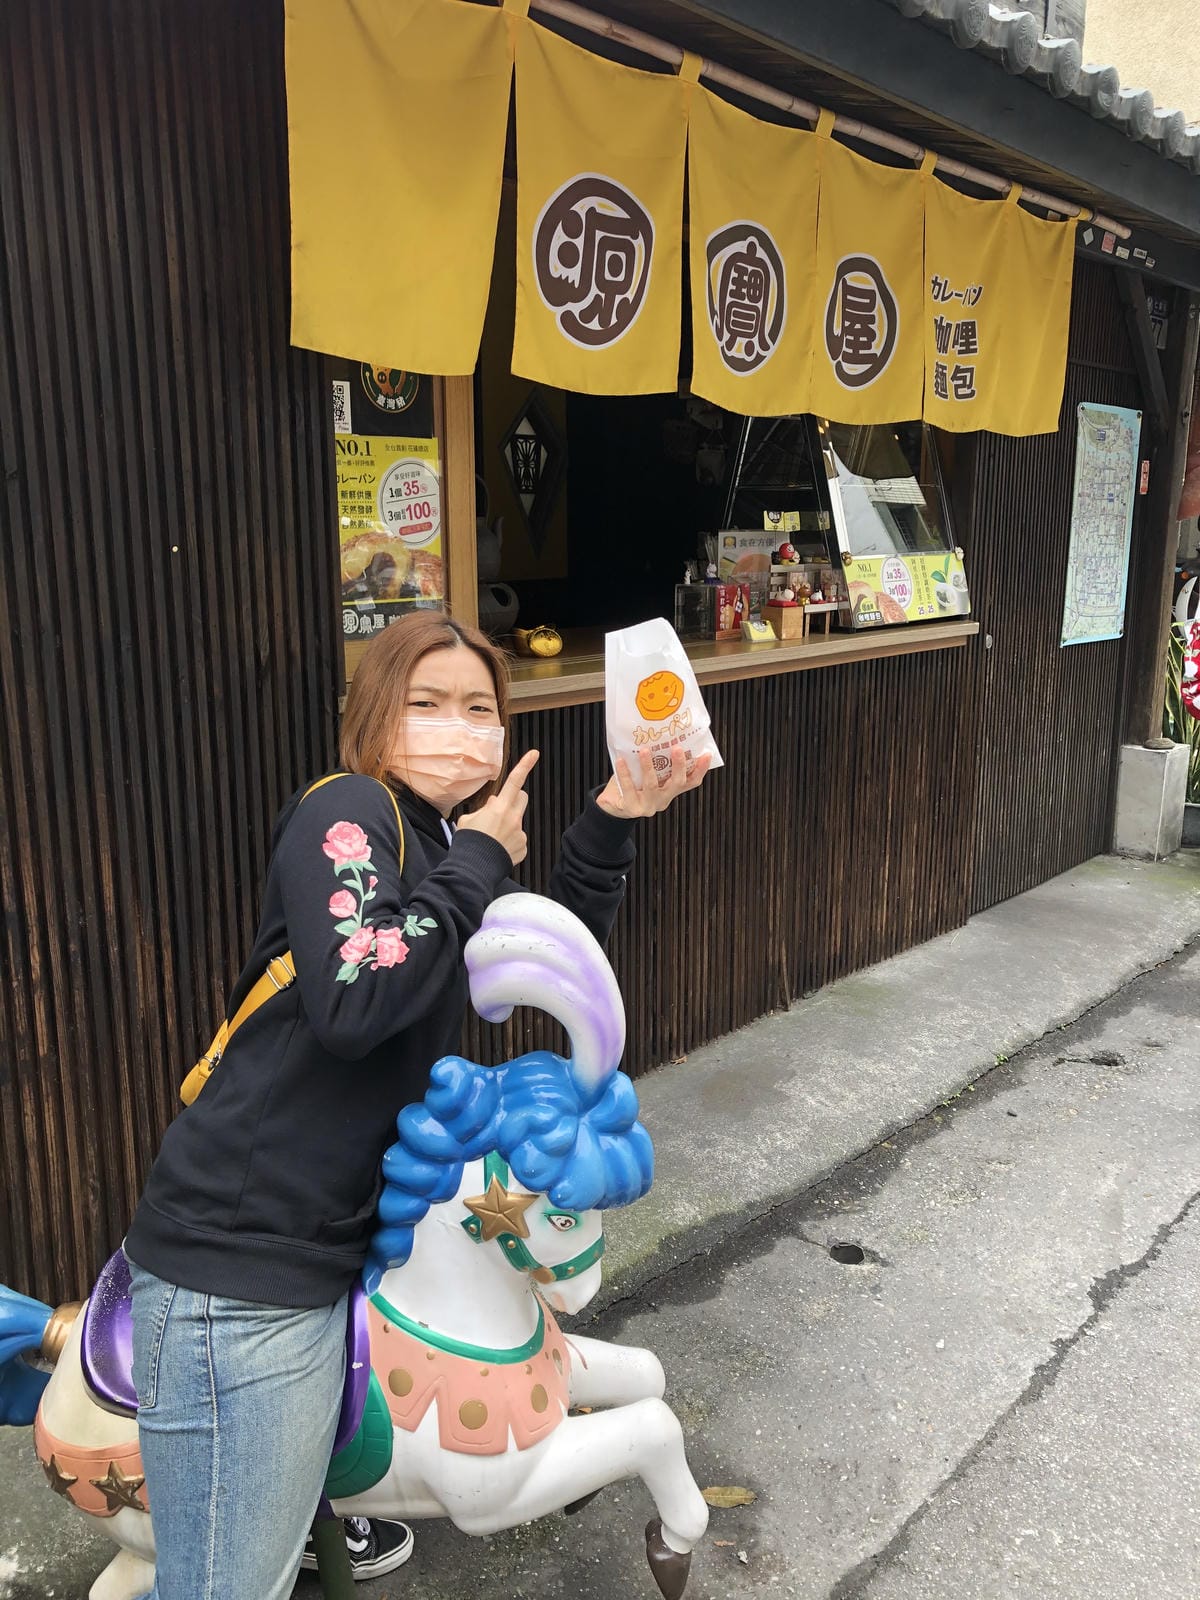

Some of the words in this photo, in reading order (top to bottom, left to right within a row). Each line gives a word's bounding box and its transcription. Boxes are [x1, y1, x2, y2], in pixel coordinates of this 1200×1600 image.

[934, 316, 978, 356] 咖哩
[335, 439, 372, 457] NO.1
[341, 490, 373, 500] 新鮮供應
[403, 480, 420, 497] 35
[341, 504, 373, 515] 天然發酵
[406, 501, 431, 521] 100
[895, 583, 907, 597] 100
